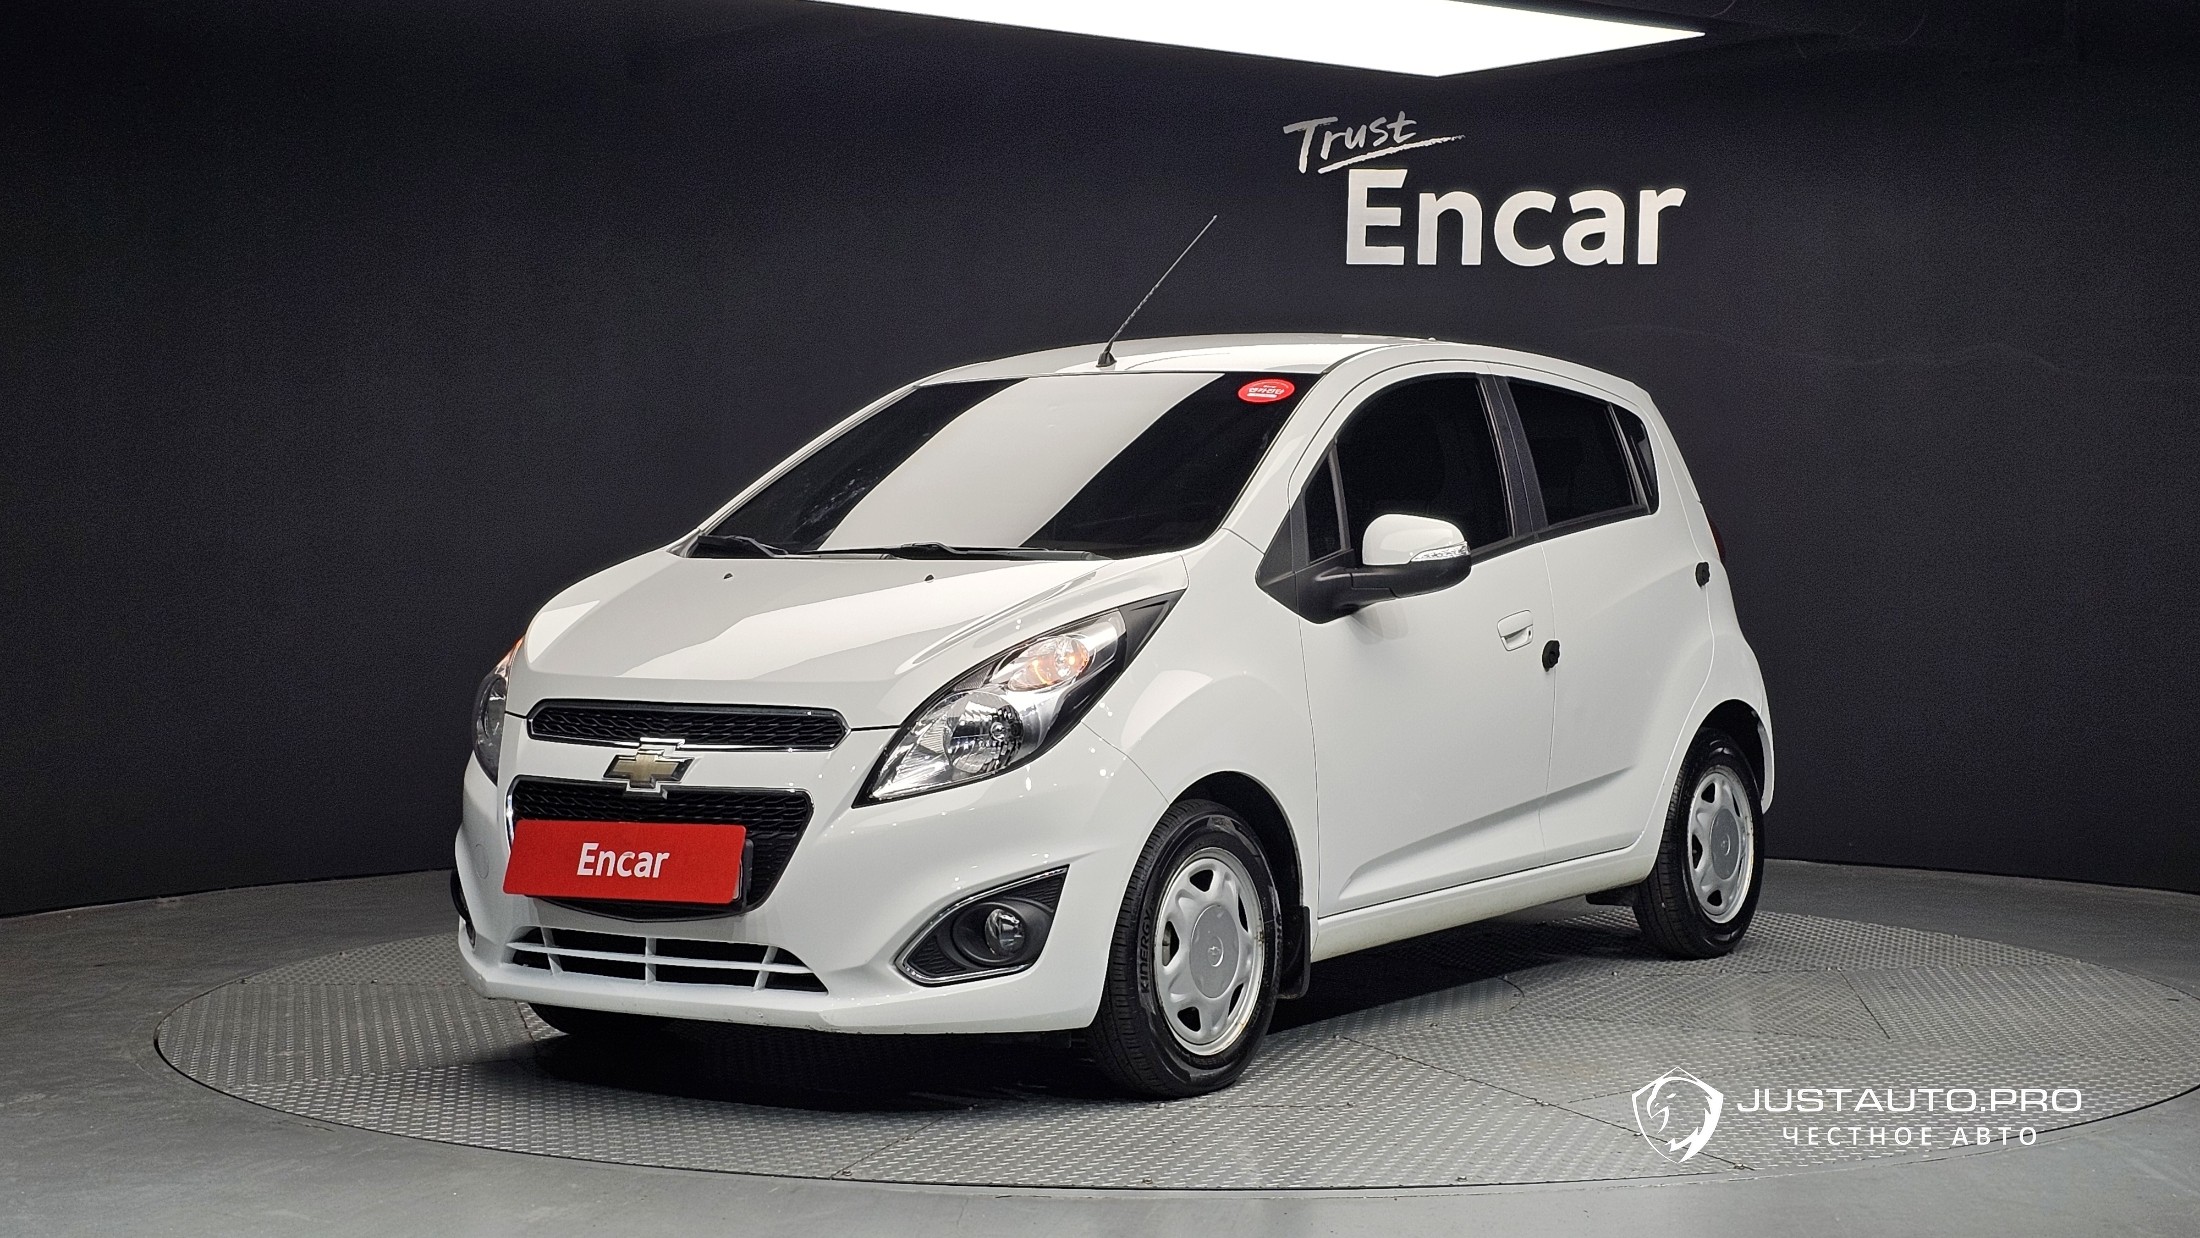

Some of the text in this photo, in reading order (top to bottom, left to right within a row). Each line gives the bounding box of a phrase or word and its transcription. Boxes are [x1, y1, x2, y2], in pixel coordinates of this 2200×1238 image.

[1283, 110, 1418, 174] Trust
[1346, 168, 1686, 266] Encar
[577, 842, 669, 878] Encar
[1140, 907, 1153, 993] KINERGY
